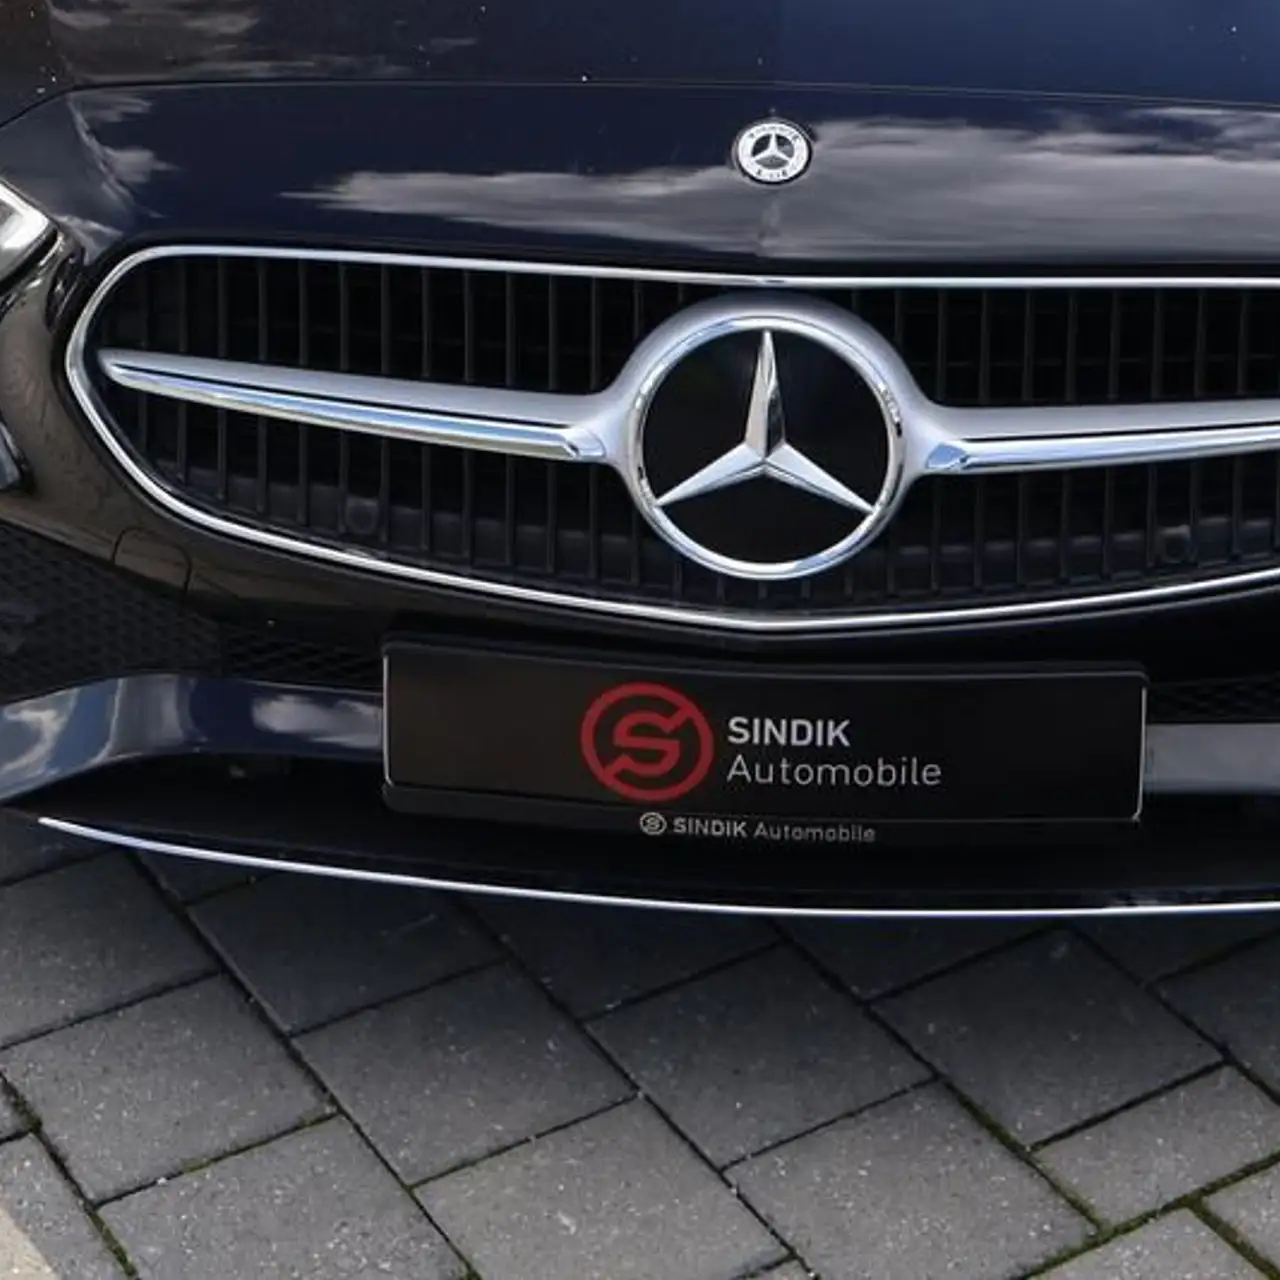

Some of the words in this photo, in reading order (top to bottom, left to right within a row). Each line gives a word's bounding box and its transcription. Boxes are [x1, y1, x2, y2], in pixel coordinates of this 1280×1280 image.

[726, 716, 851, 747] SINDIK
[726, 753, 942, 787] Automobile
[673, 817, 747, 837] SINDIK
[754, 821, 876, 843] Automobile
